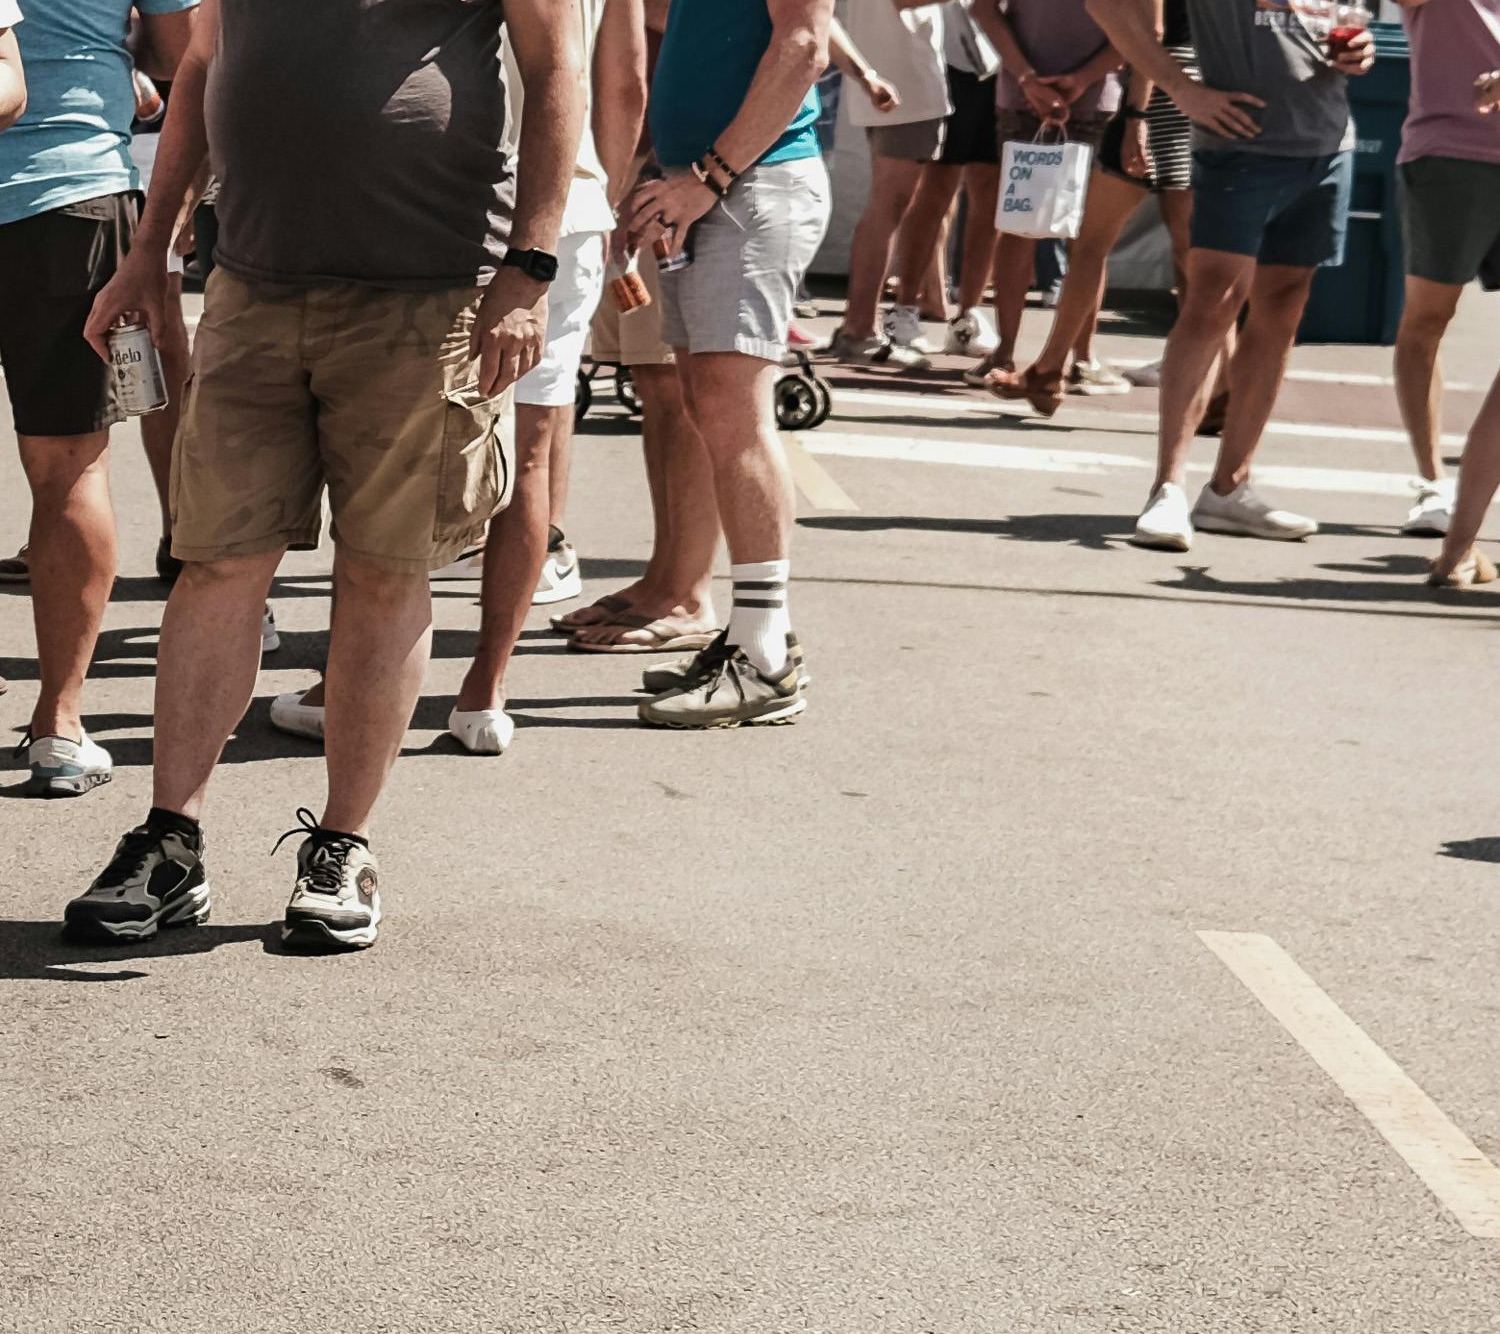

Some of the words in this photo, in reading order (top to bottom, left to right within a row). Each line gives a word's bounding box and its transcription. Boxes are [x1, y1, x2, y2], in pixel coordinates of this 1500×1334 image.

[1013, 150, 1063, 165] WORDS
[1009, 166, 1032, 180] ON
[1005, 183, 1016, 195] A
